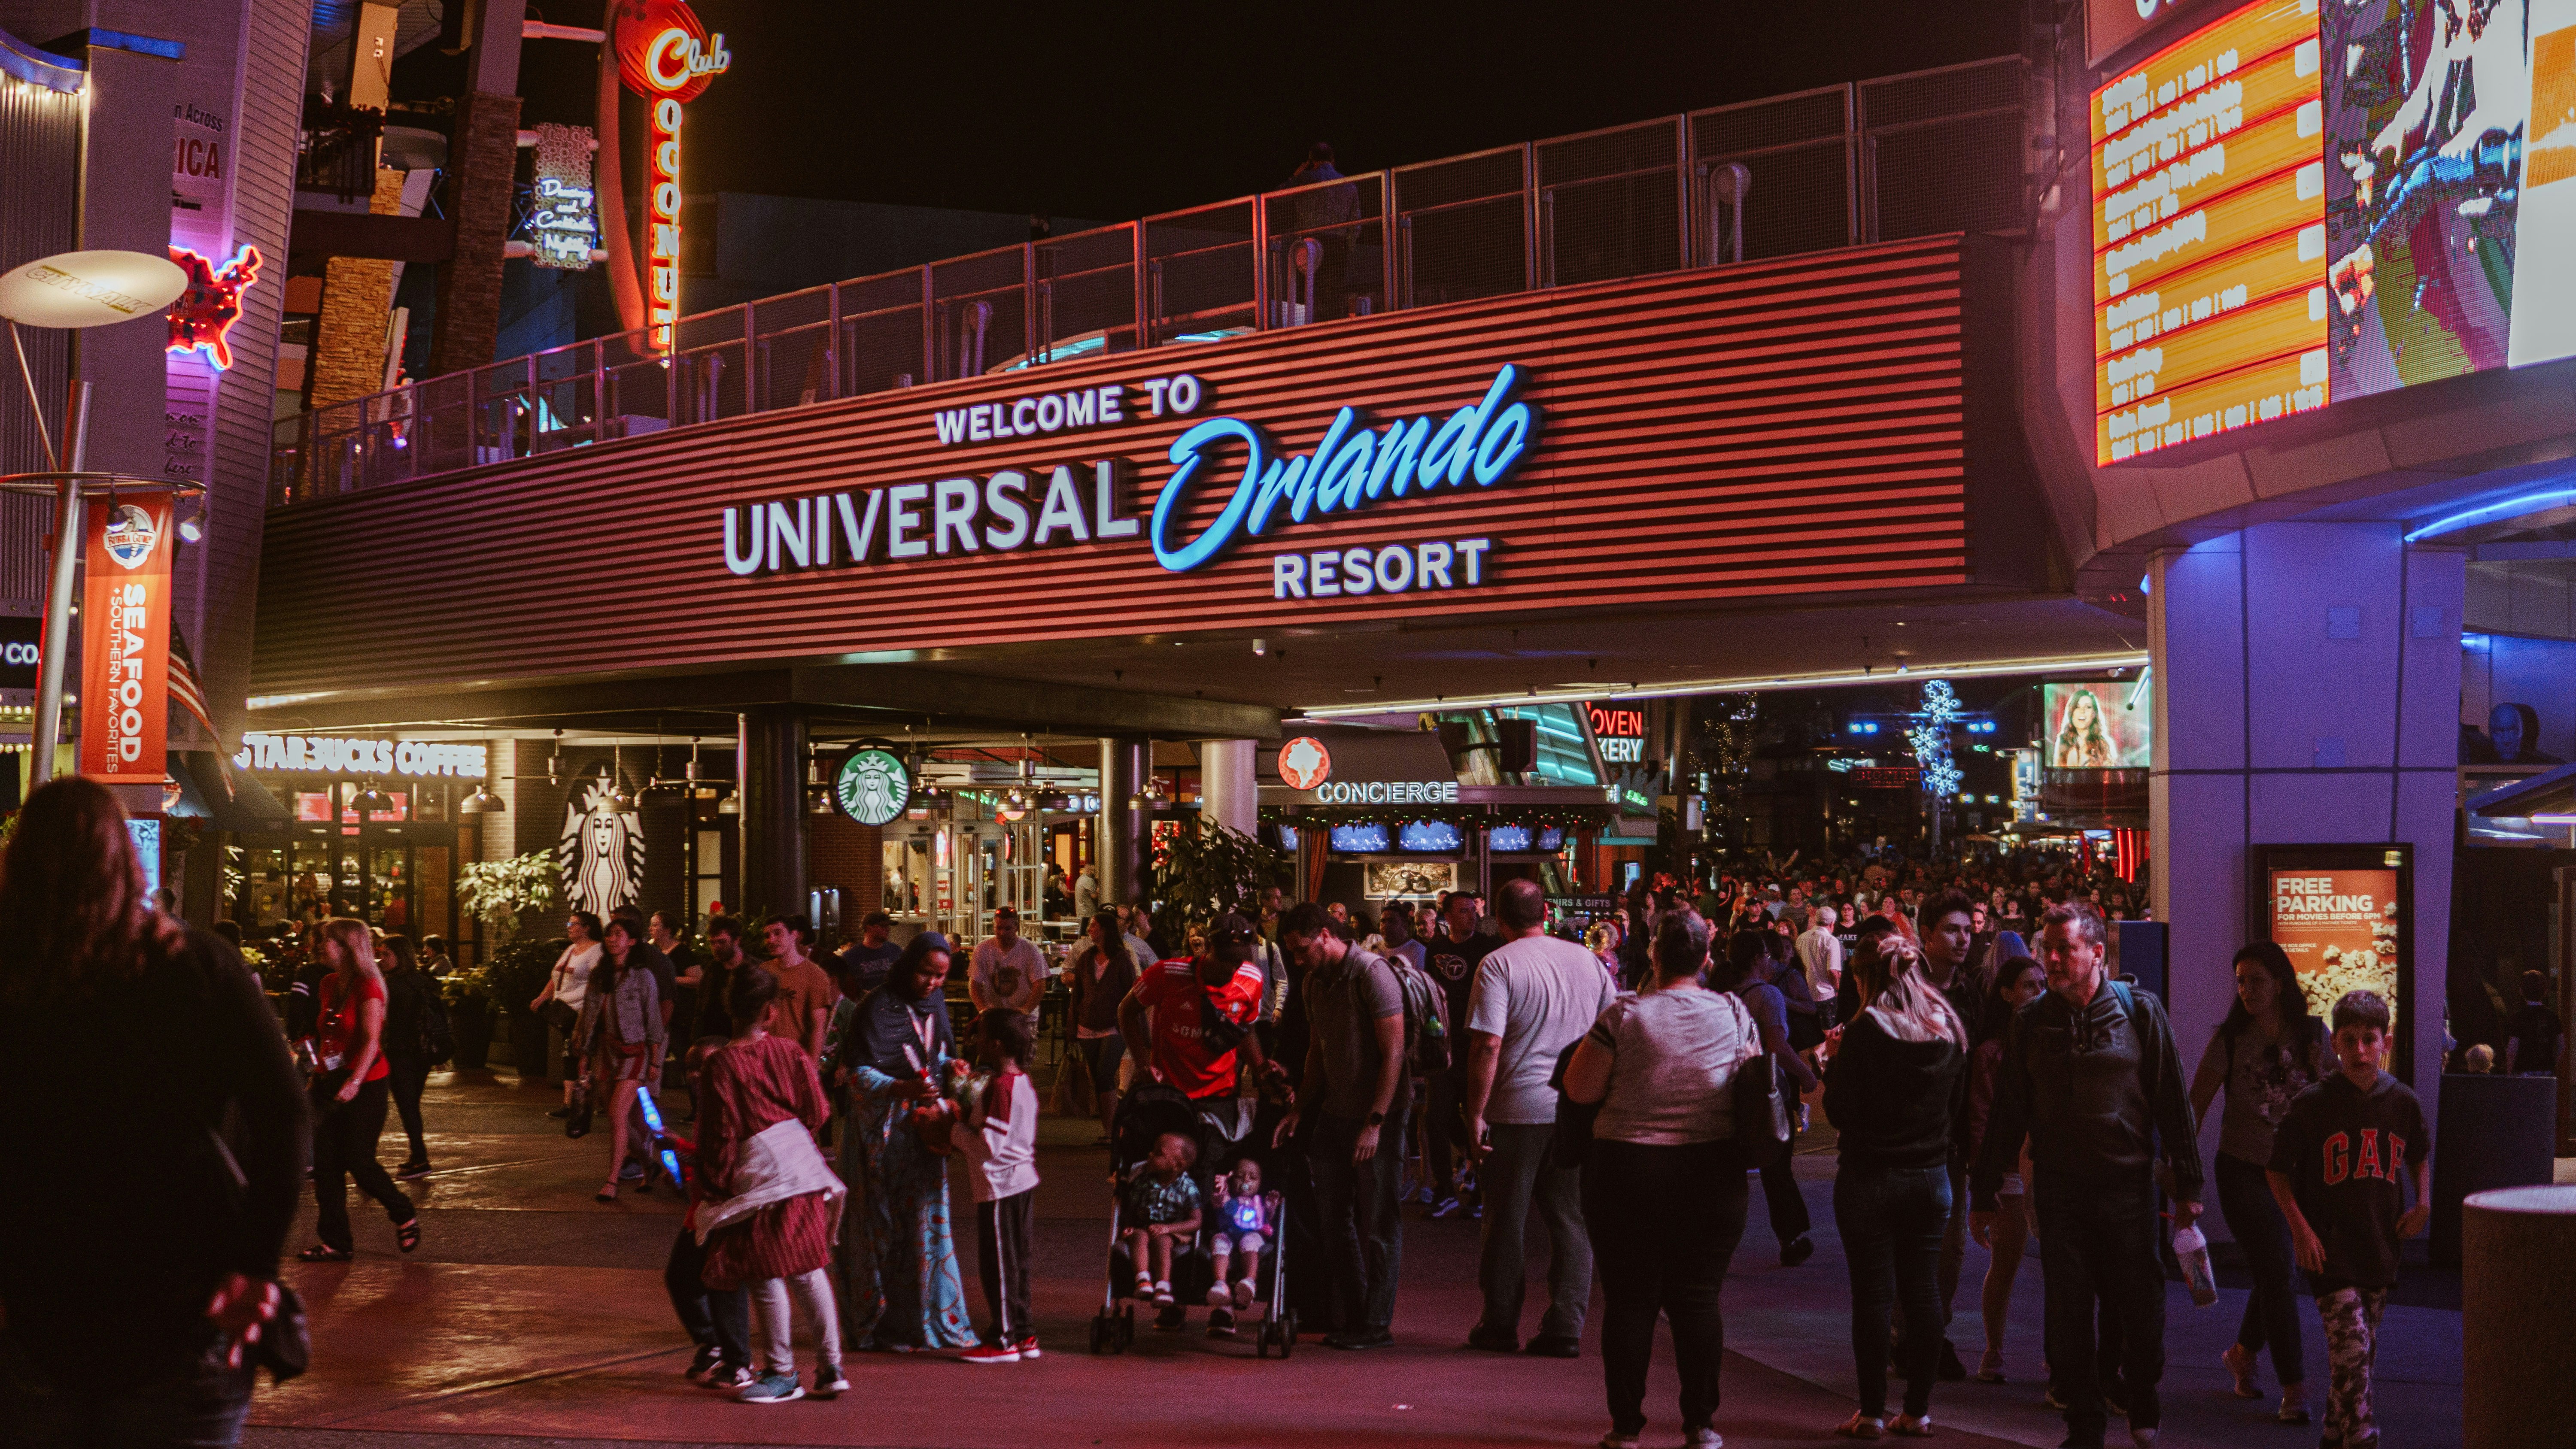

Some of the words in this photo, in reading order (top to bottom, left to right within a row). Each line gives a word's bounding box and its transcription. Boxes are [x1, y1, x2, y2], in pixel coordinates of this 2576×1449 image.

[645, 27, 731, 91] Club
[185, 103, 223, 133] Across
[935, 385, 1124, 445] WELCOME
[1144, 374, 1200, 416] TO
[723, 460, 1139, 576] UNIVERSAL
[1151, 363, 1530, 572] Orlando
[1273, 538, 1490, 600] RESORT
[109, 596, 123, 683] SOUTHERN
[120, 583, 146, 762] SEAFOOD
[106, 688, 119, 773] FAVORITES
[1591, 709, 1642, 736] OVEN
[234, 734, 393, 773] STARBUCKS
[395, 741, 487, 777] COFFEE
[1315, 781, 1458, 803] CONCIERGE
[2277, 877, 2333, 894] FREE
[2277, 895, 2374, 912] PARKING
[2323, 1128, 2406, 1185] GAP
